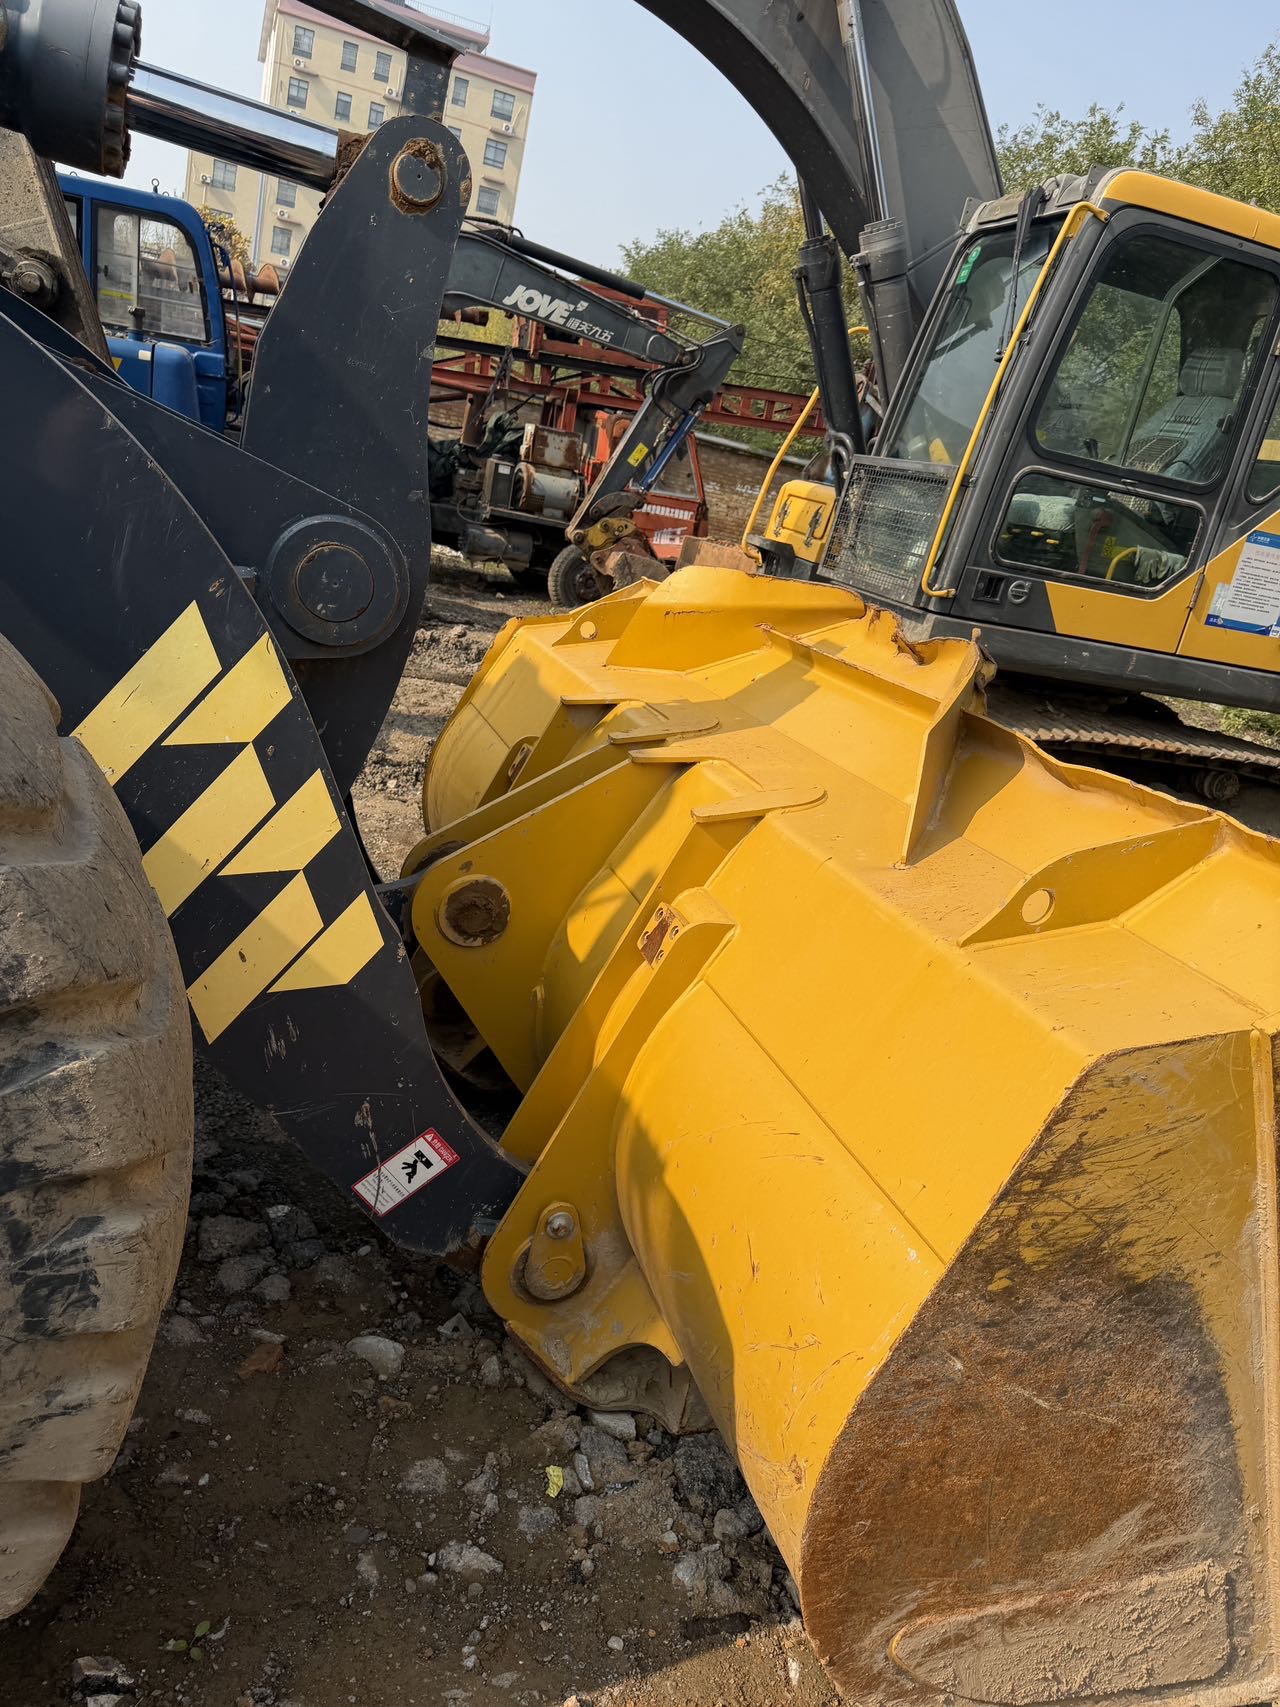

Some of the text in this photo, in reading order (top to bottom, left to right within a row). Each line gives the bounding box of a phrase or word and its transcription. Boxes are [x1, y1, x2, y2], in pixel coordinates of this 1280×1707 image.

[502, 284, 575, 325] JOVE
[566, 317, 614, 342] 恒天九五
